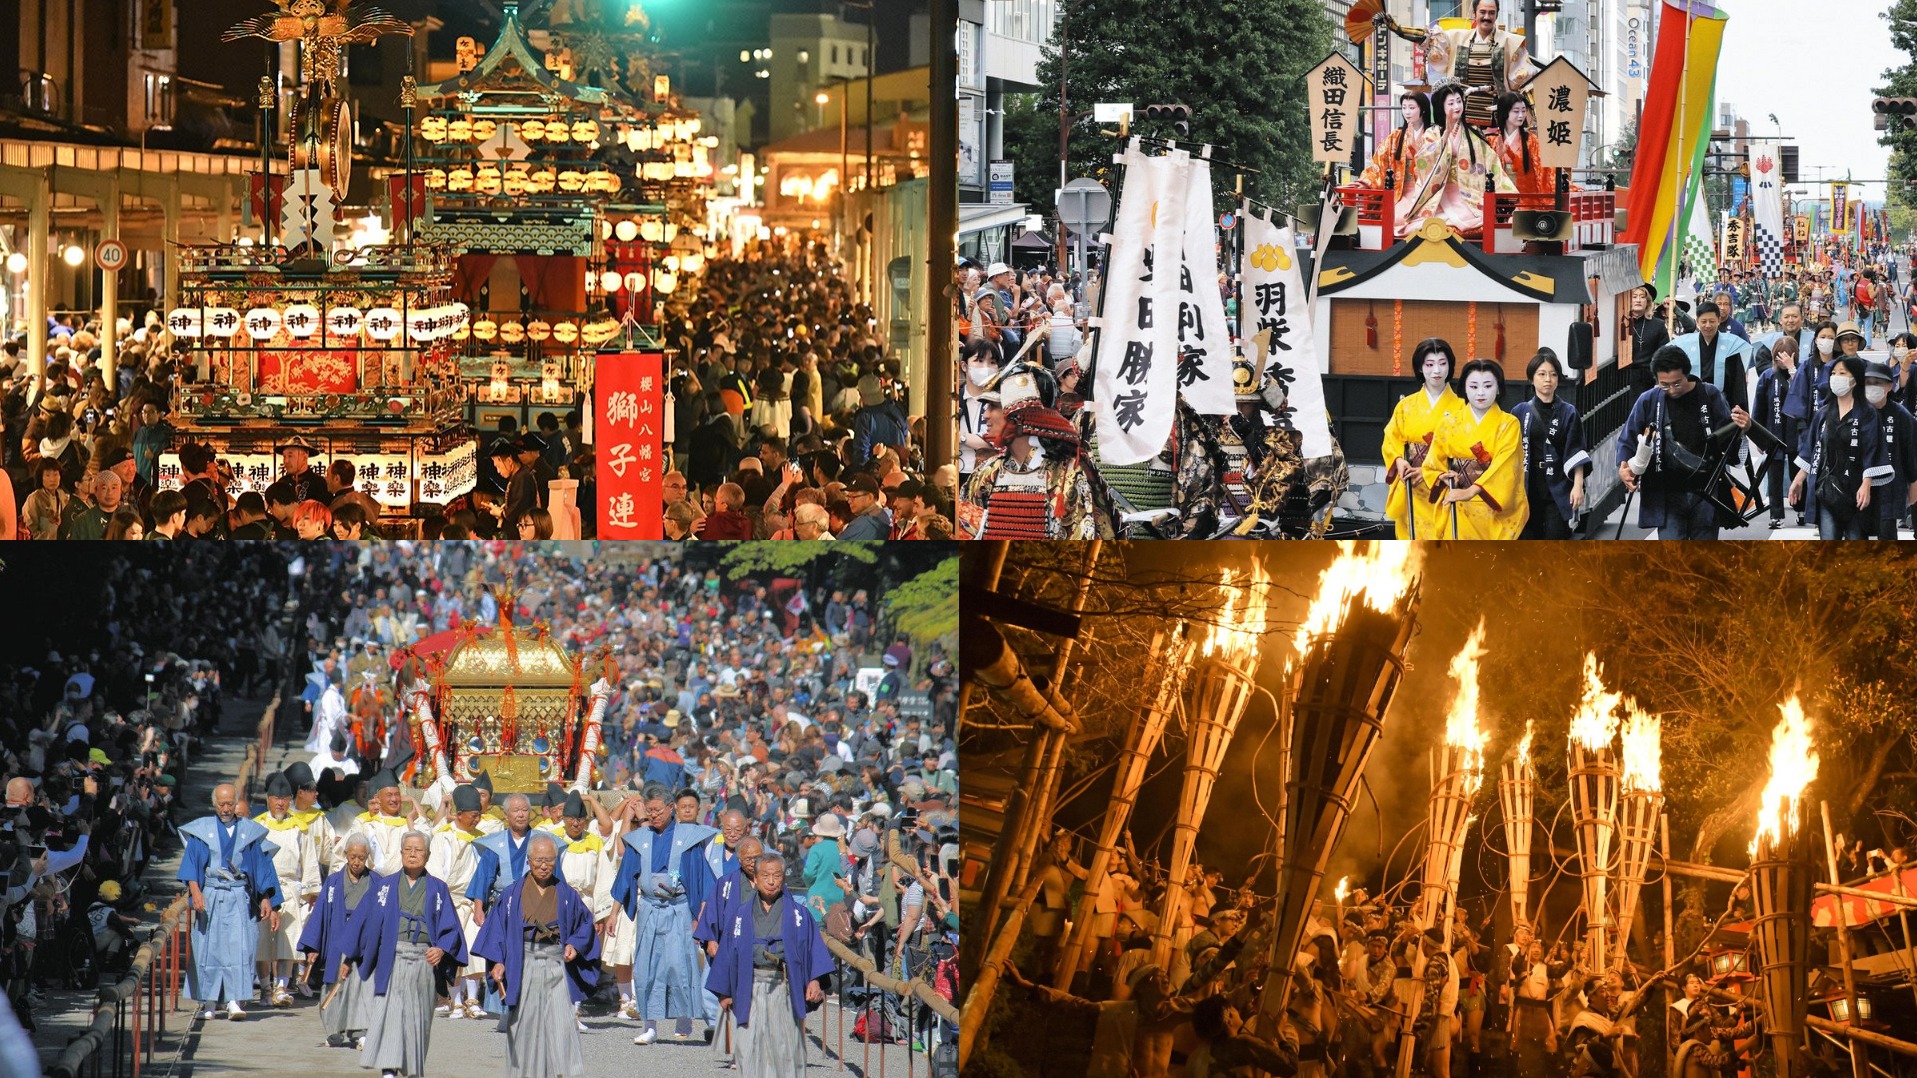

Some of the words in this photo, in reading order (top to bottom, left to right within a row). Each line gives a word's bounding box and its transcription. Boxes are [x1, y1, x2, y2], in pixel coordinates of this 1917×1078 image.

[1628, 17, 1640, 57] Ocean
[1628, 59, 1641, 78] 43
[1320, 65, 1349, 153] 織田信長
[1547, 84, 1573, 147] 濃姫
[1726, 220, 1741, 258] 秀吉隊
[103, 248, 120, 262] 40
[169, 314, 192, 331] 神
[213, 312, 237, 330] 神
[249, 316, 271, 332] 神
[287, 312, 309, 329] 神
[333, 313, 358, 329] 神
[370, 316, 393, 332] 神
[414, 317, 437, 333] 神
